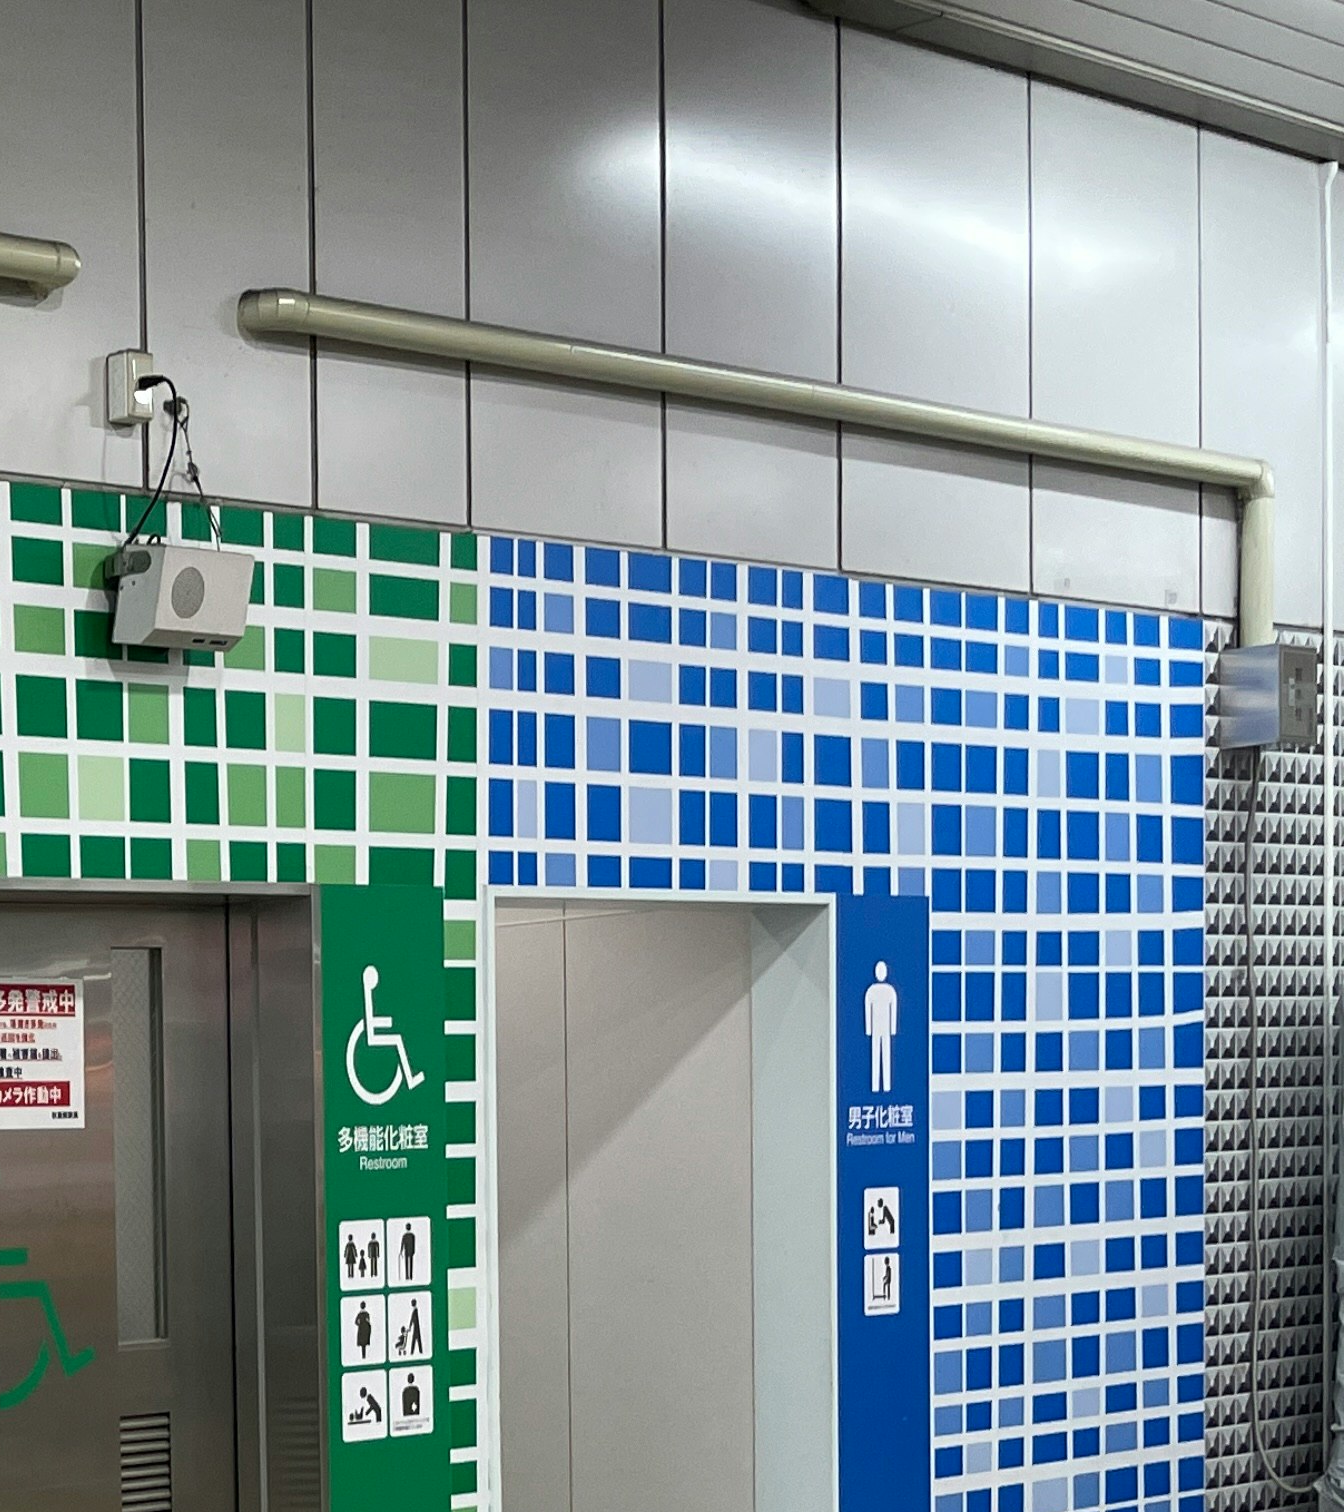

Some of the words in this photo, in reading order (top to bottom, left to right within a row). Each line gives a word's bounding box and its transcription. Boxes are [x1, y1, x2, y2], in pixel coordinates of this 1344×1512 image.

[848, 1104, 913, 1129] 男子化粧室
[337, 1123, 429, 1153] 多機能化粧室
[847, 1132, 884, 1146] Restroom
[885, 1131, 896, 1144] for
[898, 1130, 915, 1144] Men
[359, 1155, 408, 1171] Restroom
